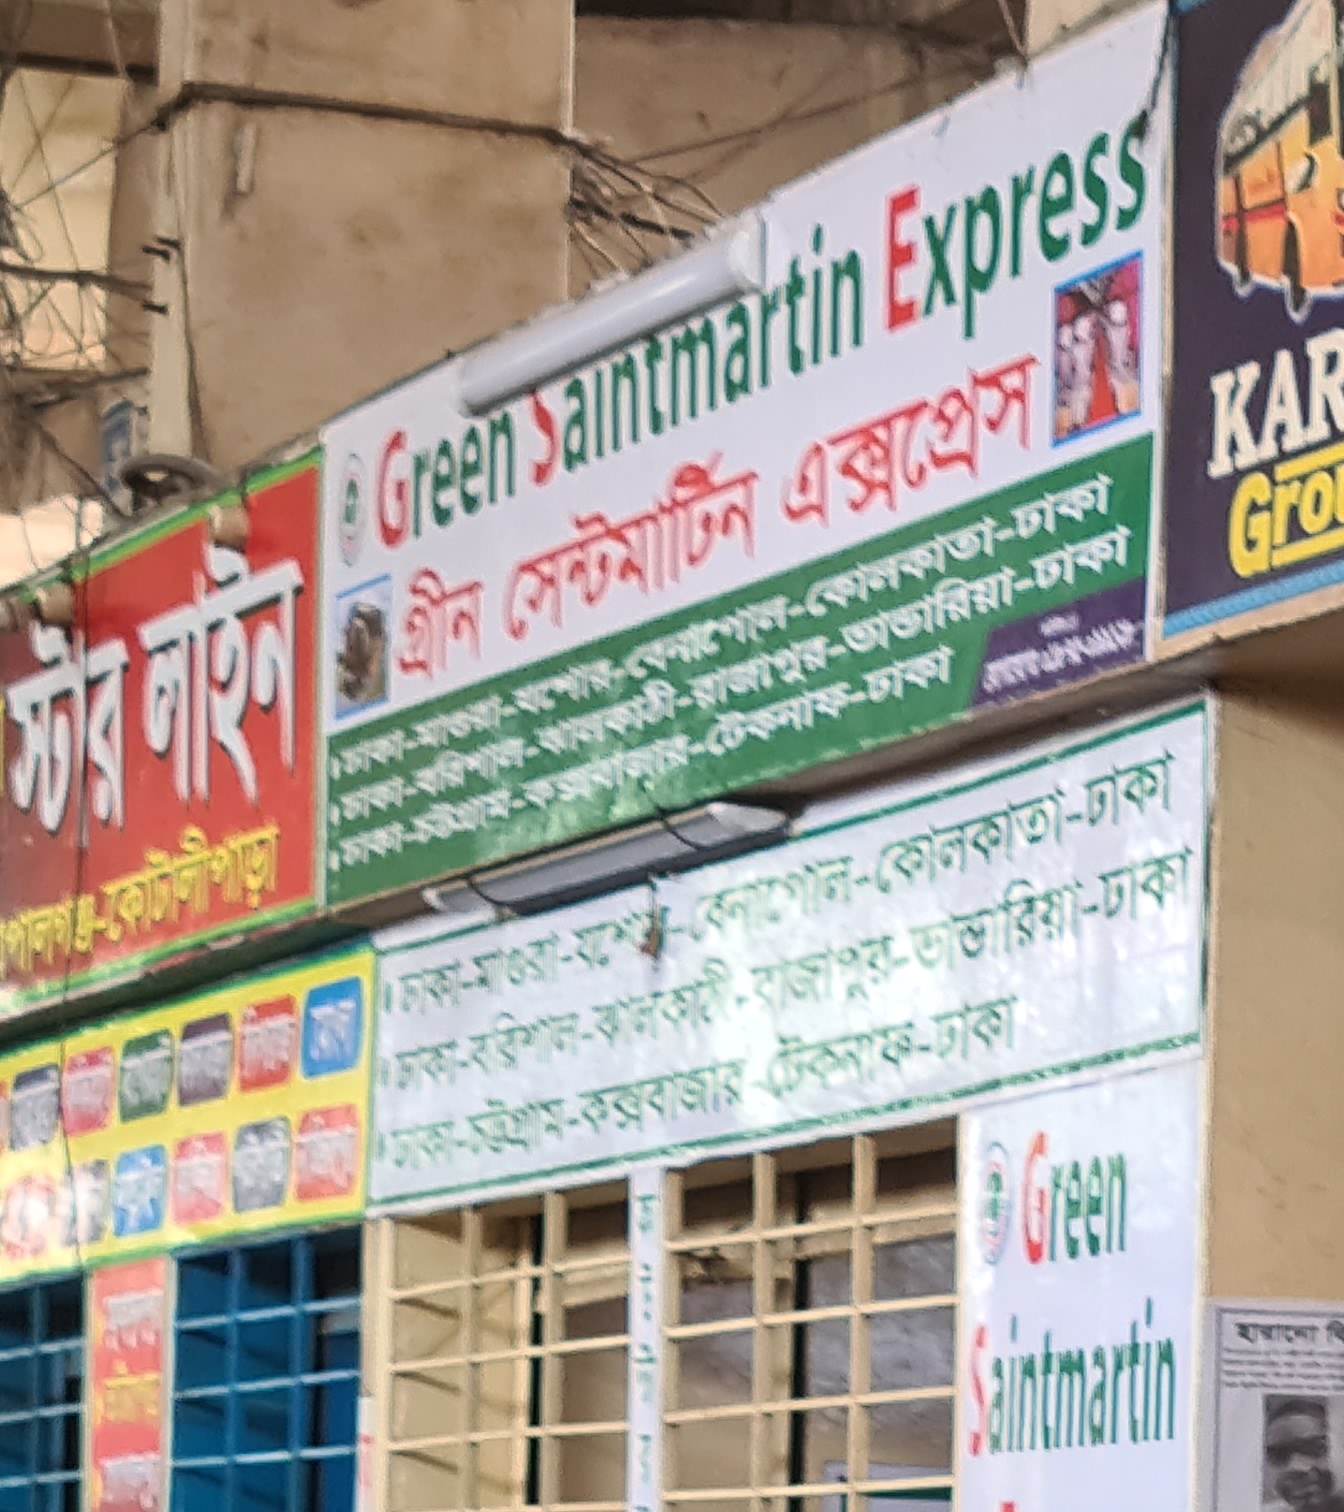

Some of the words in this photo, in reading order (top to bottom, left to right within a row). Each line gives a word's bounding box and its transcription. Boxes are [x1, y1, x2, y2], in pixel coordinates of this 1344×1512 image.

[374, 411, 514, 550] Green
[529, 225, 864, 486] Saintmartin
[885, 122, 1147, 339] Express
[398, 568, 484, 679] গ্রীন
[782, 354, 1041, 528] এক্সপ্রেস
[5, 619, 130, 848] স্টার
[137, 542, 304, 809] লাইন
[1022, 1131, 1127, 1264] Green
[969, 1297, 1176, 1456] Saintmartin
